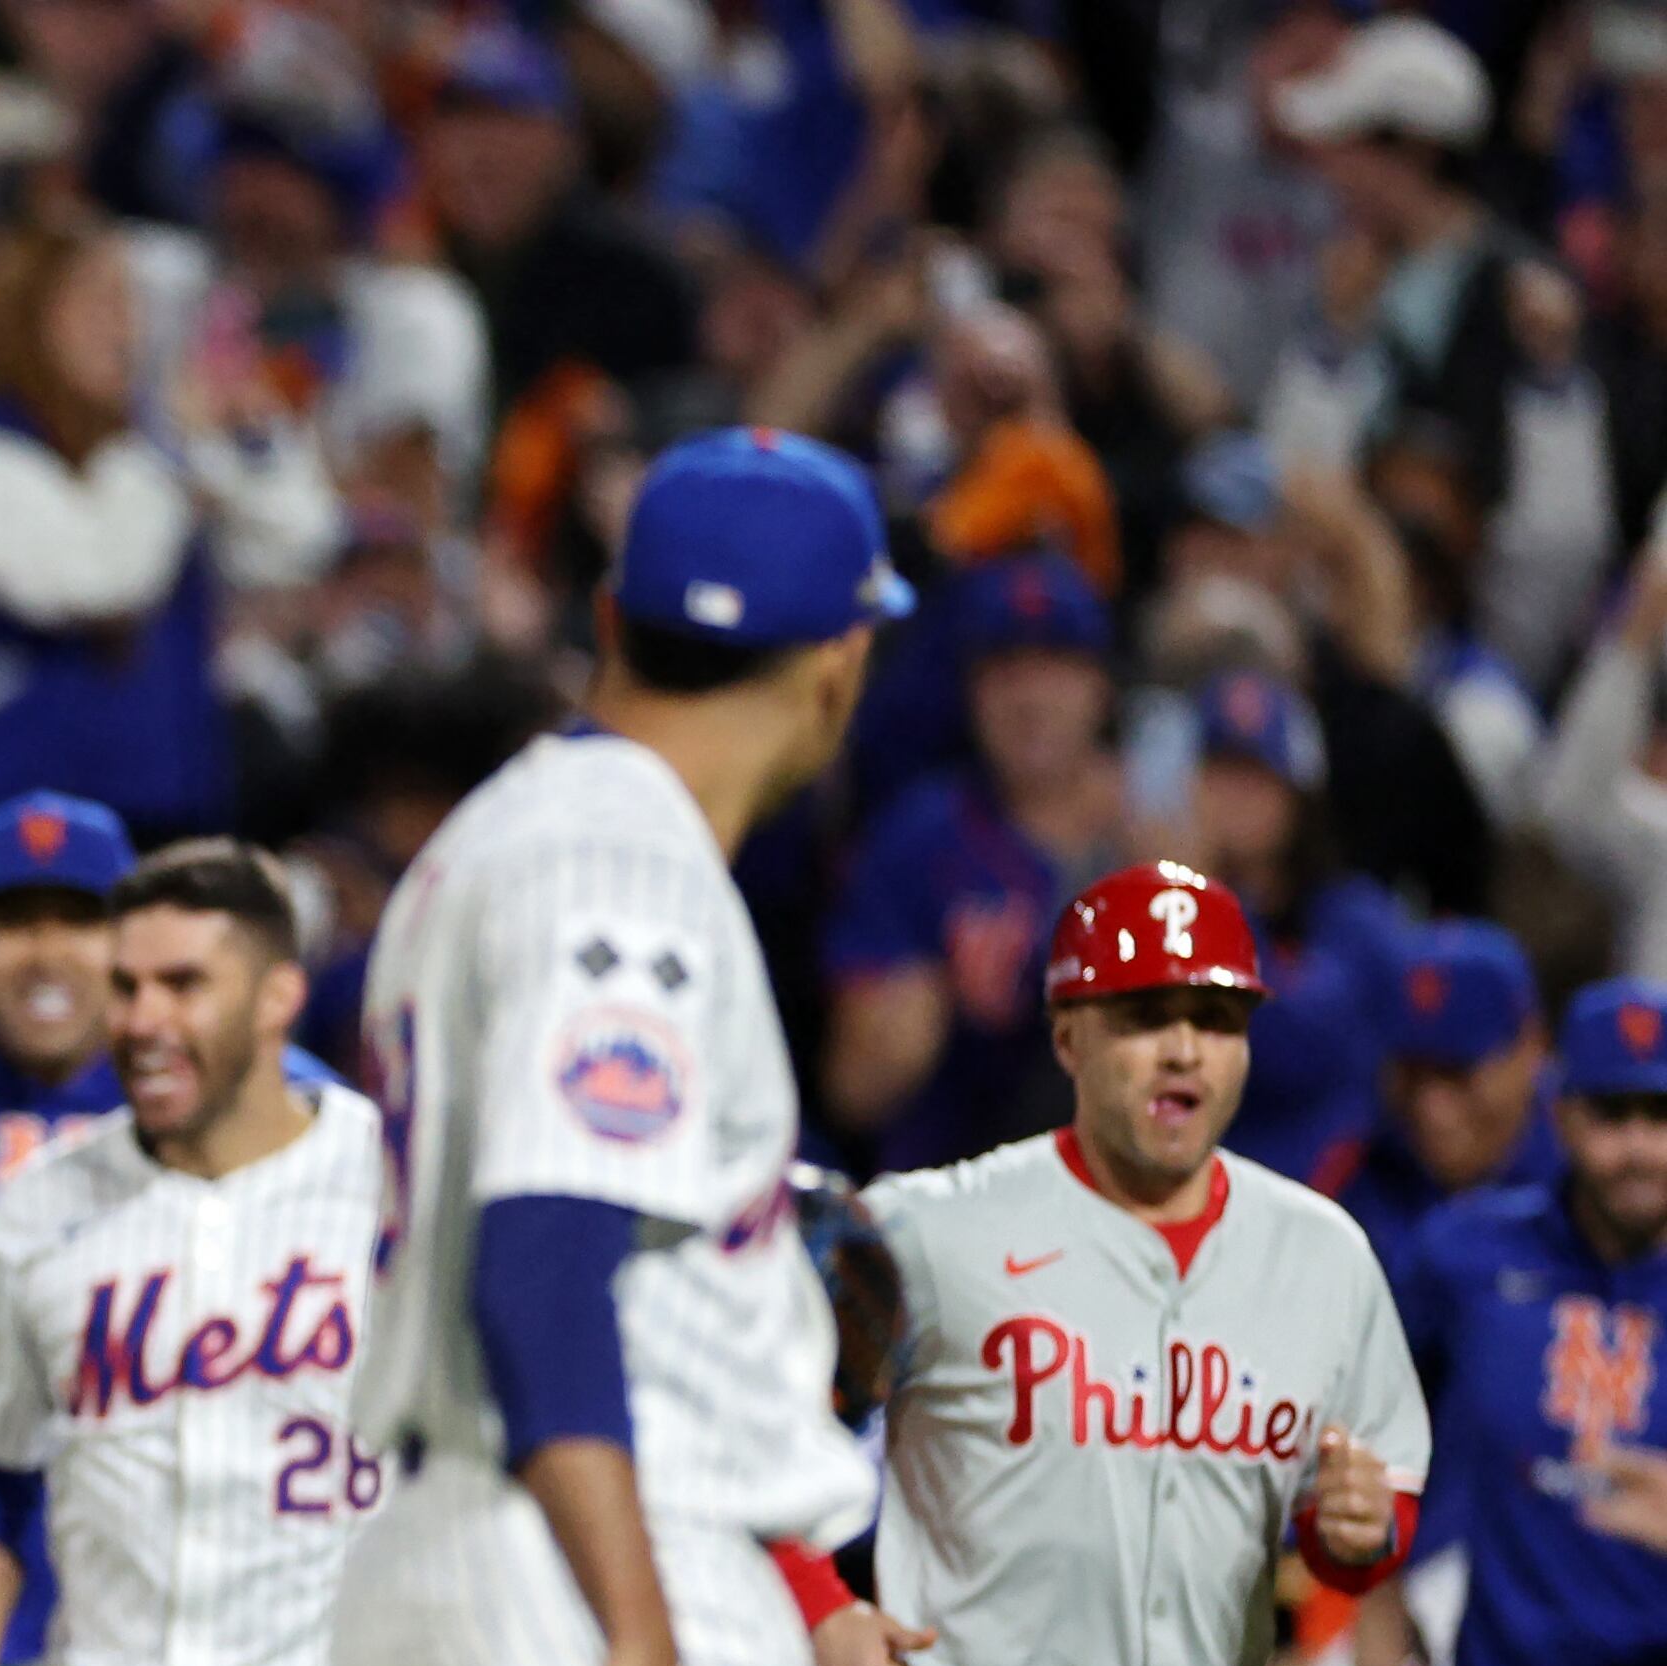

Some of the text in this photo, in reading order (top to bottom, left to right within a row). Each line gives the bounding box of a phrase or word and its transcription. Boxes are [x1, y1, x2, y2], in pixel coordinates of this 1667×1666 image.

[1149, 888, 1199, 958] P
[64, 1256, 354, 1419] Mets
[980, 1312, 1314, 1461] Phillie
